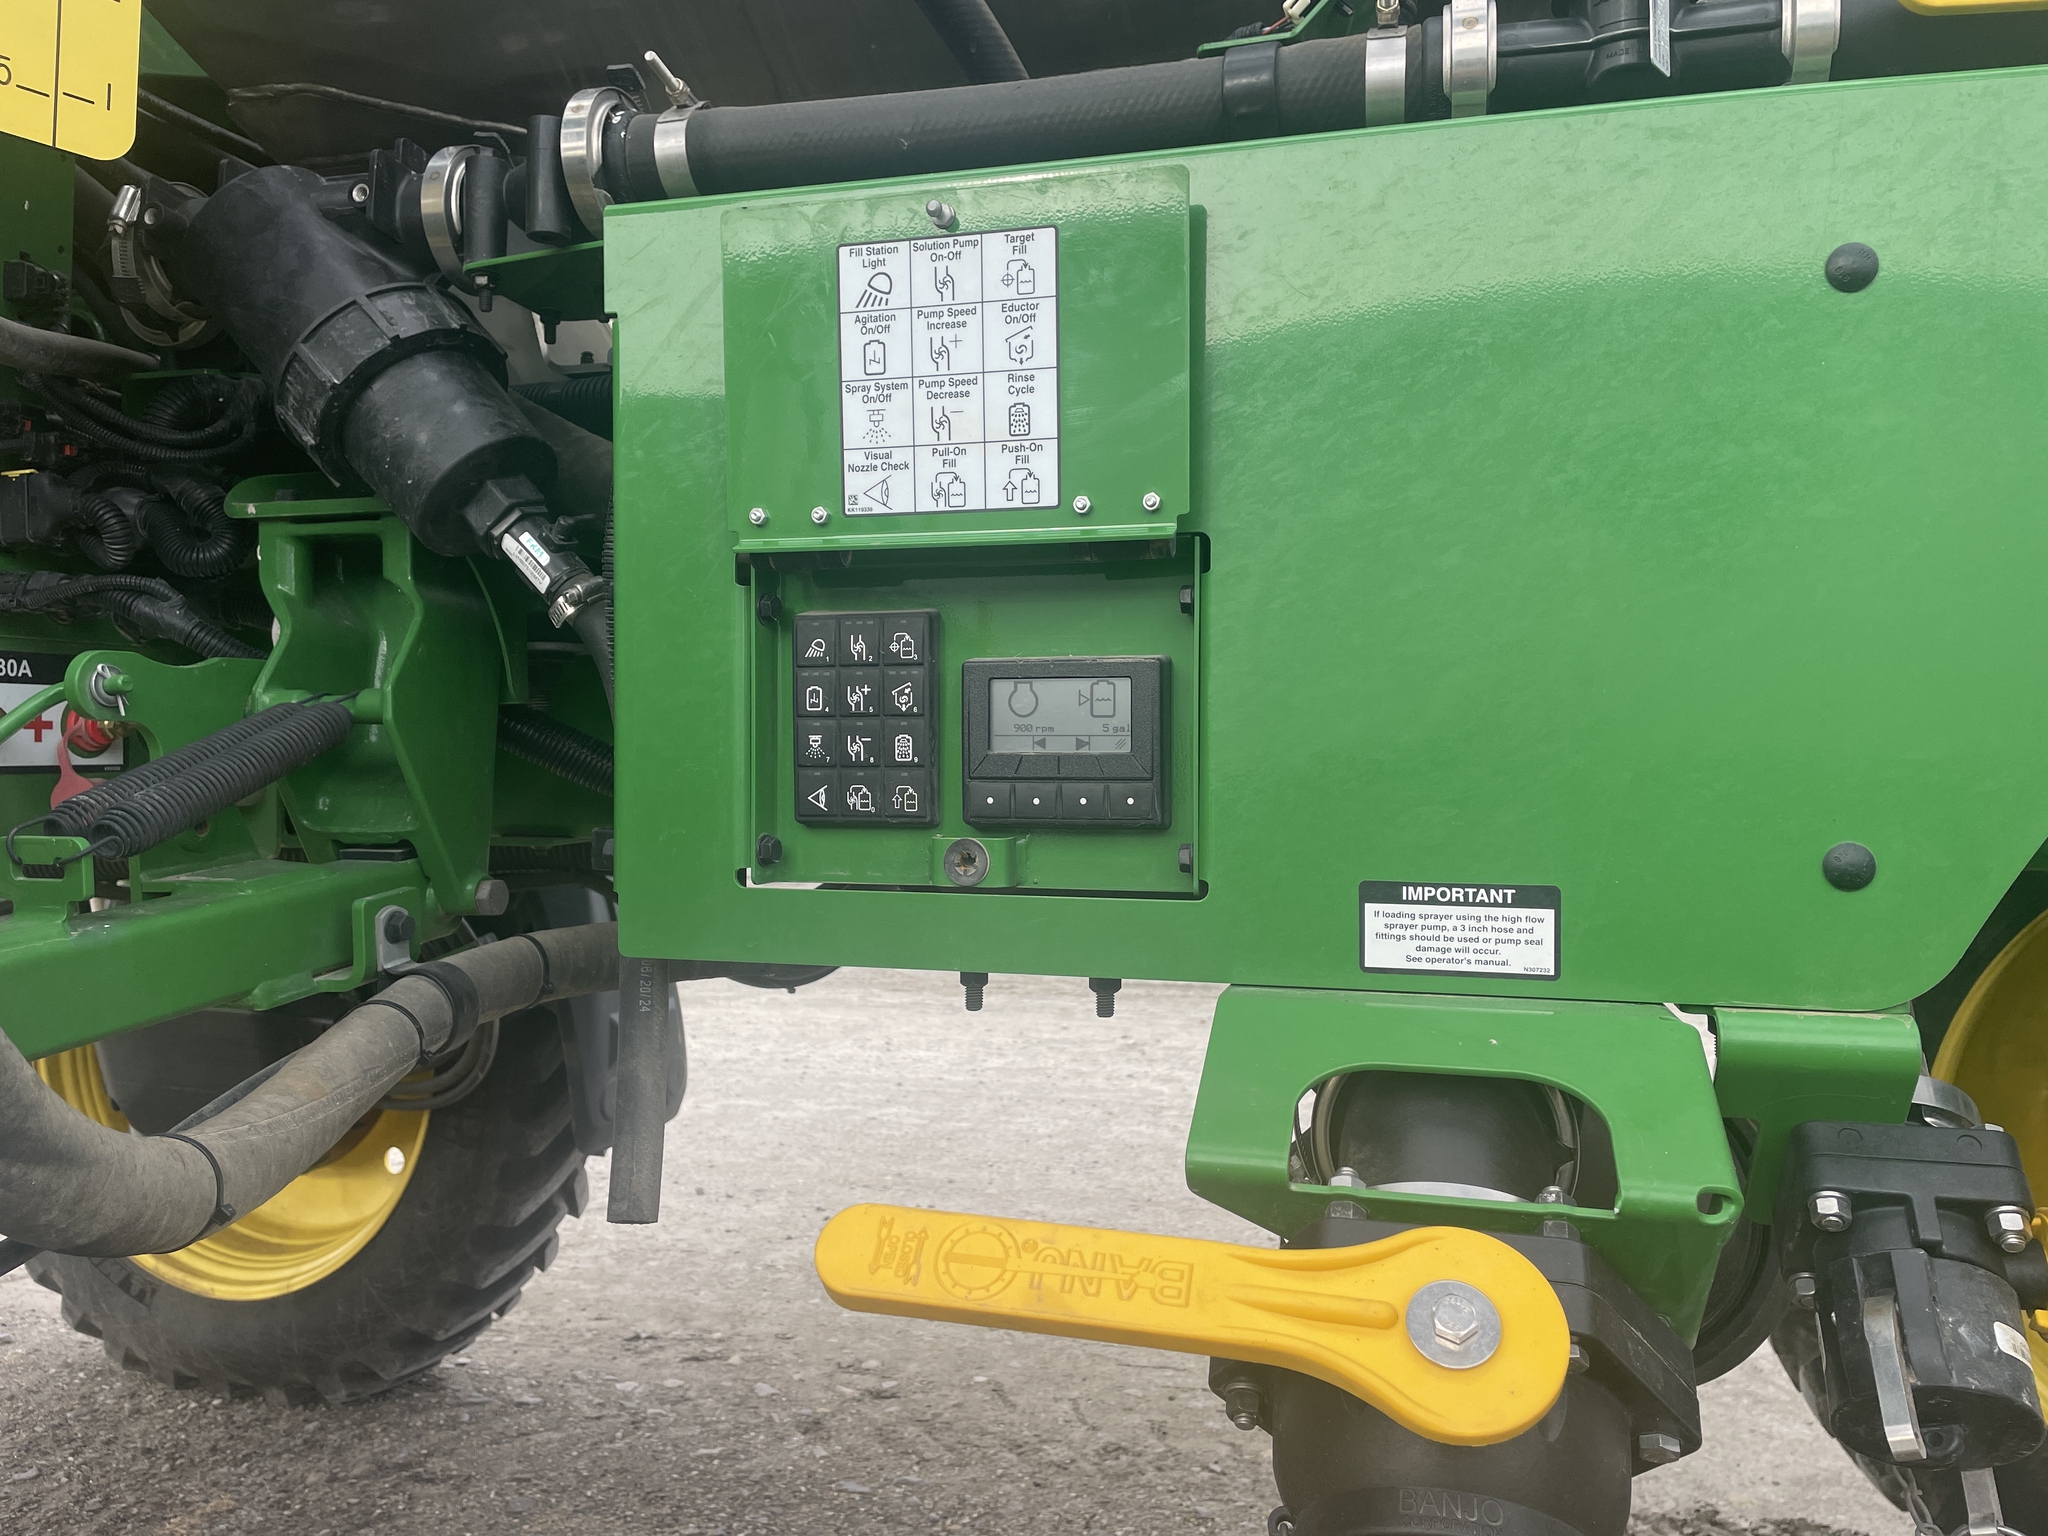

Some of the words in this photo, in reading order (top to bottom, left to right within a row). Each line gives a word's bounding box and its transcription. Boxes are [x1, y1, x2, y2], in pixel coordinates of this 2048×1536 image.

[1004, 232, 1035, 244] Target
[912, 240, 950, 252] Solution
[952, 238, 979, 249] Pump
[1012, 244, 1027, 255] Fill
[849, 247, 863, 258] Fill
[865, 245, 899, 256] Station
[930, 250, 962, 263] On-Off
[862, 257, 886, 270] Light
[917, 309, 945, 320] Pump
[947, 305, 977, 319] Speed
[1001, 302, 1040, 313] Eductor
[854, 312, 896, 324] Agitation
[1004, 312, 1036, 325] On/Off
[860, 324, 891, 335] On/Off
[927, 320, 967, 331] Increase
[918, 379, 946, 390] Pump
[948, 375, 978, 389] Speed
[1007, 373, 1035, 383] Rinse
[845, 383, 872, 396] Spray
[874, 381, 909, 394] System
[1008, 384, 1035, 397] Cycle
[861, 392, 892, 404] On/Off
[926, 390, 971, 400] Decrease
[932, 446, 967, 457] Pull-On
[1001, 442, 1043, 454] Push-On
[863, 450, 893, 461] Visual
[1015, 454, 1030, 465] Fill
[848, 462, 878, 473] Nozzle
[880, 461, 910, 472] Check
[942, 458, 957, 468] Fill
[1013, 723, 1033, 733] 900
[1102, 723, 1110, 733] 5
[1112, 724, 1131, 733] gal
[1402, 886, 1516, 904] IMPORTANT
[1382, 910, 1416, 921] loading
[1418, 913, 1453, 922] sprayer
[1456, 913, 1482, 924] using
[1484, 914, 1499, 922] the
[1502, 914, 1522, 925] high
[1525, 915, 1545, 924] flow
[1384, 923, 1418, 932] sprayer
[1420, 924, 1450, 933] pump,
[1460, 924, 1466, 932] 3
[1468, 924, 1488, 932] inch
[1491, 925, 1514, 934] hose
[1516, 926, 1534, 934] and
[1375, 932, 1407, 942] fittings
[1409, 933, 1440, 942] should
[1443, 934, 1455, 942] be
[1457, 936, 1480, 944] used
[1494, 938, 1522, 947] pump
[1415, 944, 1452, 955] damage
[1405, 954, 1423, 963] See
[1425, 957, 1472, 965] operator's
[1400, 1487, 1504, 1526] BANJO
